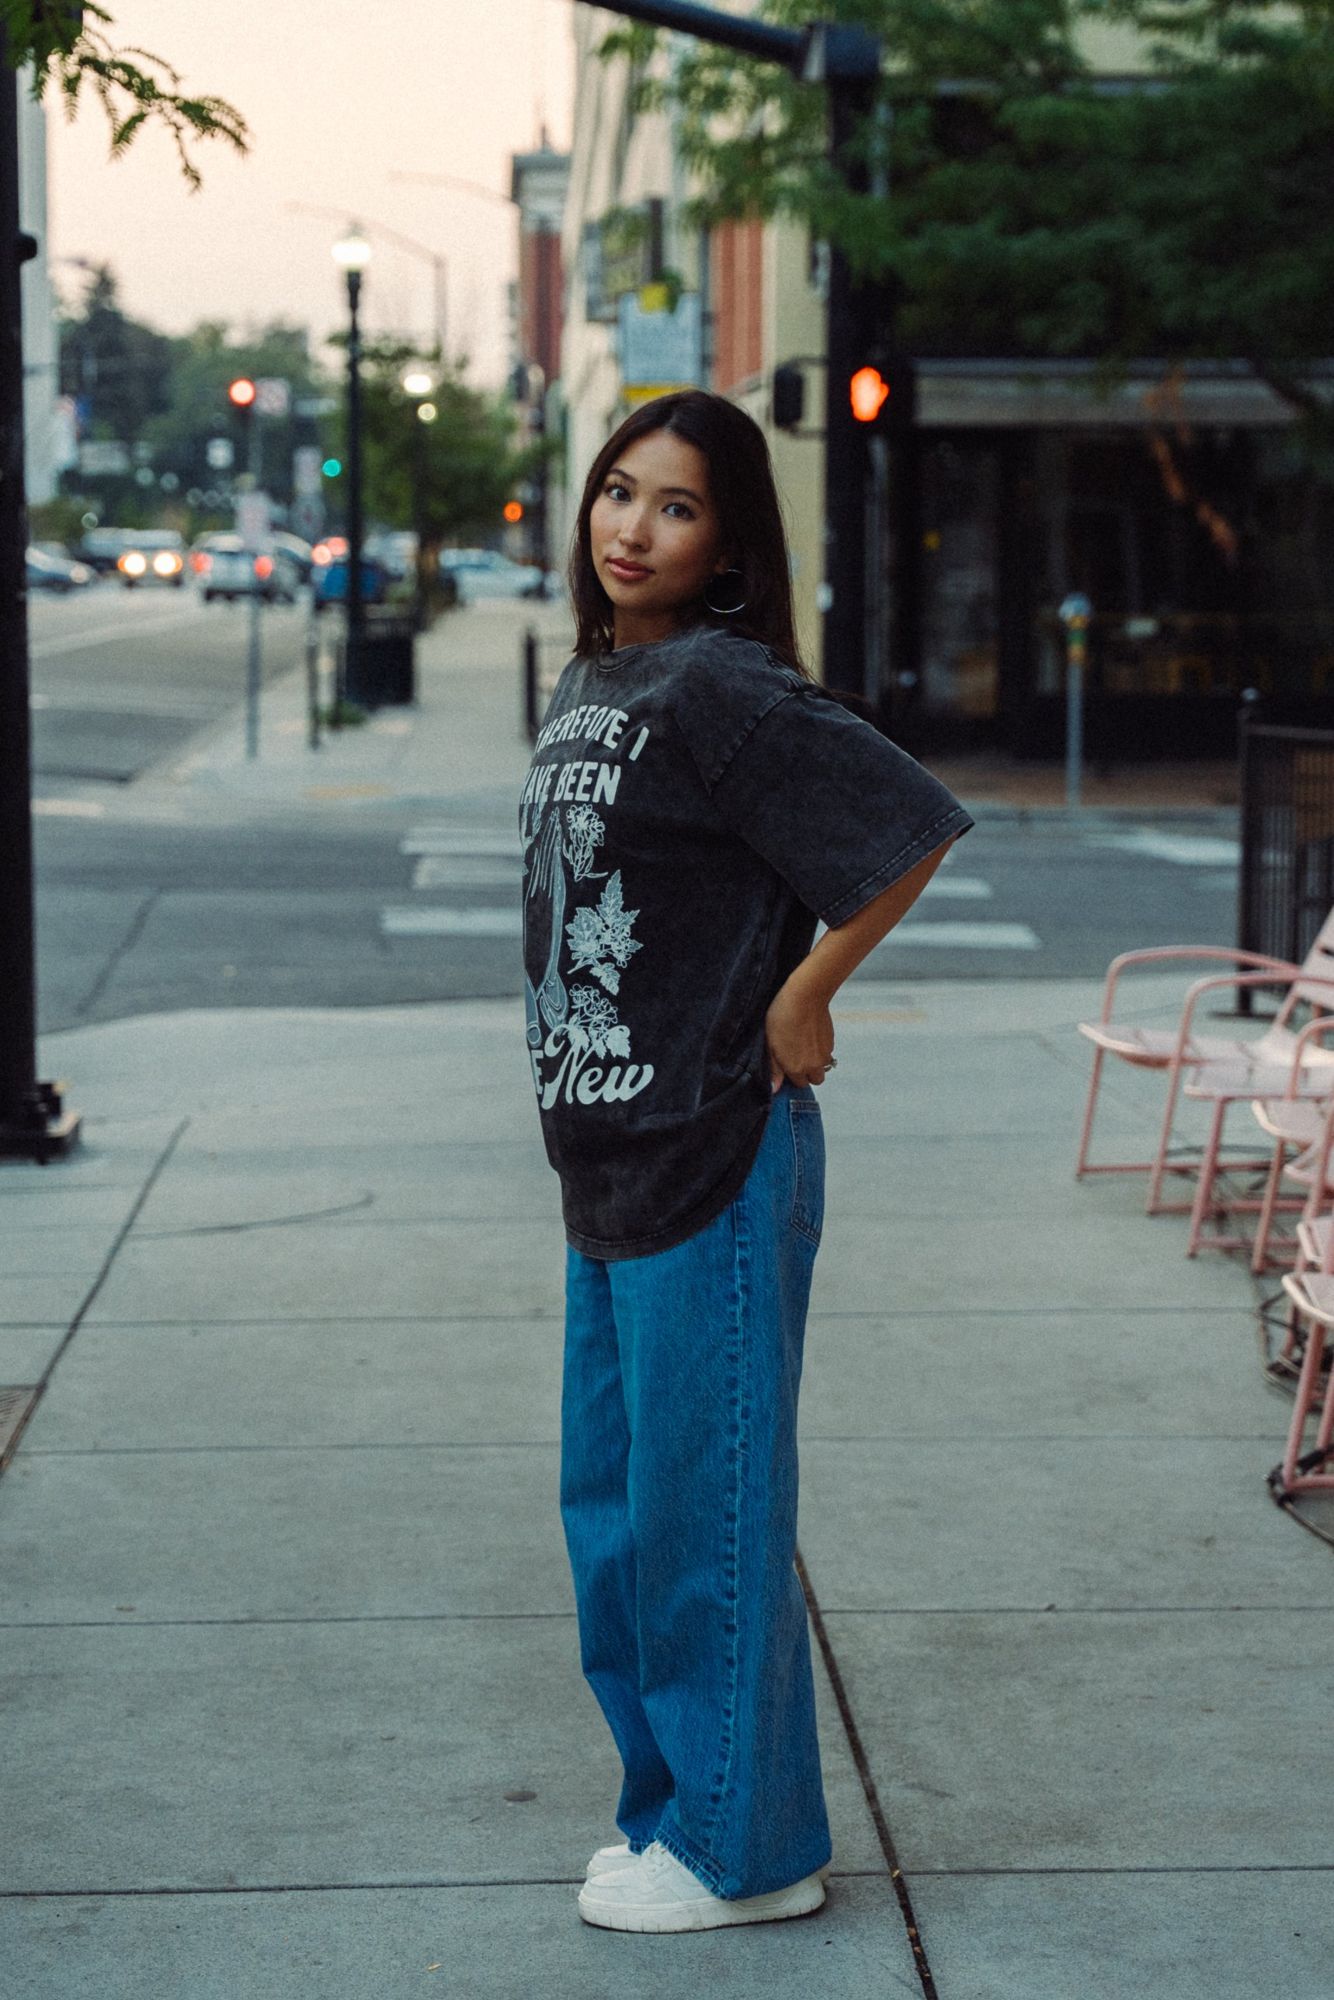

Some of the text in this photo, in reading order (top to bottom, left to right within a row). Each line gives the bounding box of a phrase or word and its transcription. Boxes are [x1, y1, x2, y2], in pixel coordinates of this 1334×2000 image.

[628, 726, 650, 762] I
[553, 761, 622, 806] BEEN
[541, 1024, 655, 1110] New
